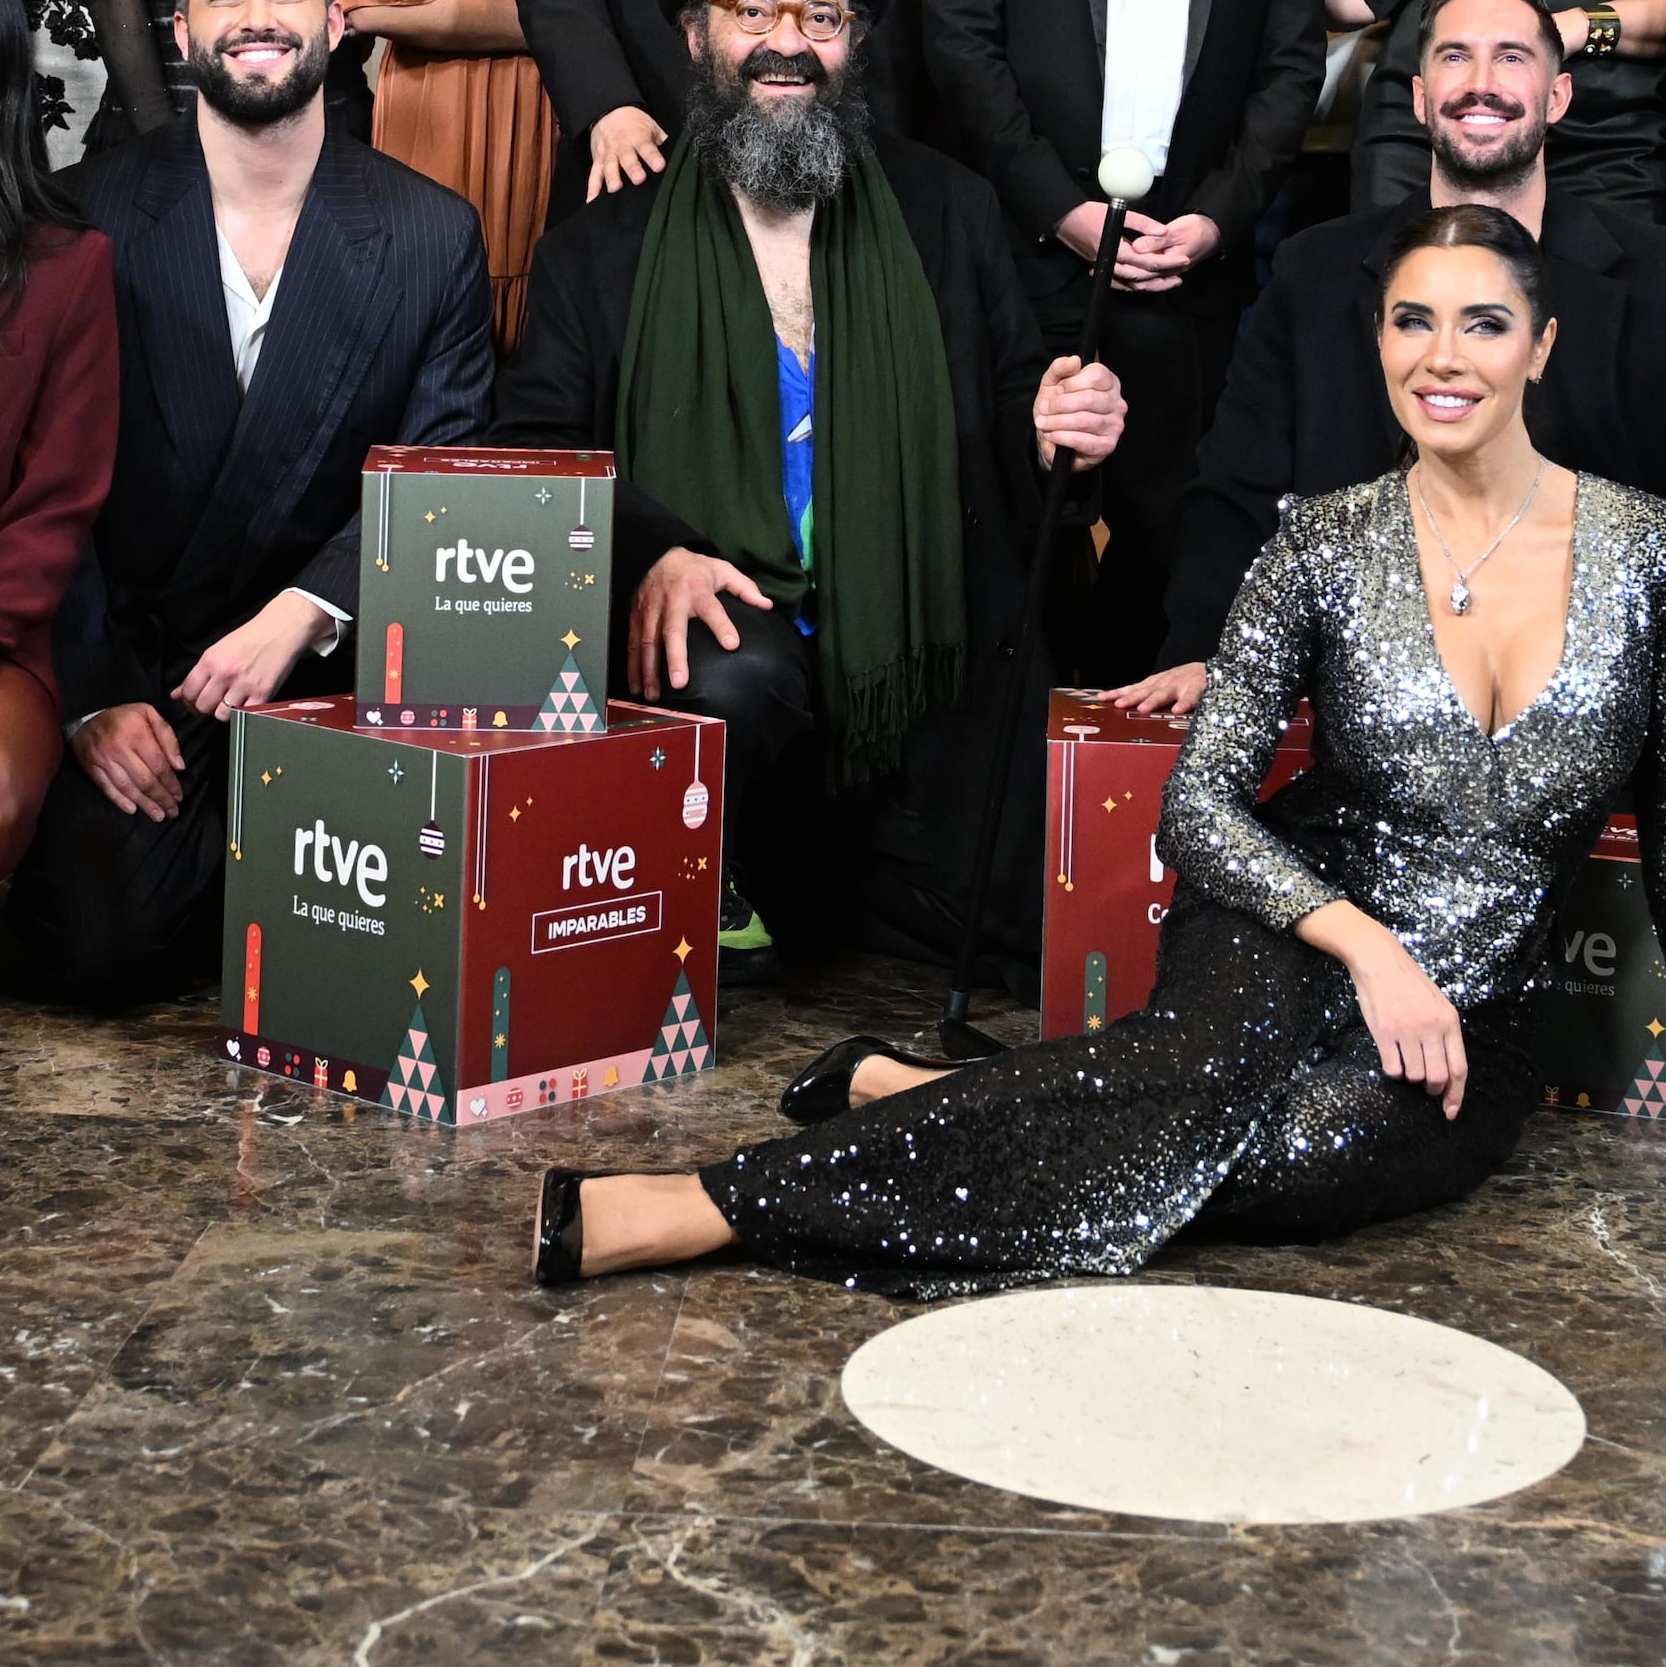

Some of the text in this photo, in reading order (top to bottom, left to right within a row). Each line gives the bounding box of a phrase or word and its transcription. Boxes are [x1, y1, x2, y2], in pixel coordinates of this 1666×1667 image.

[435, 538, 535, 594] rtve
[435, 595, 533, 615] La que quieres
[294, 819, 388, 907] rtve
[562, 843, 636, 890] rtve
[293, 895, 385, 936] La que quieres
[548, 905, 647, 940] IMPARABLES
[1564, 930, 1617, 977] ve
[1564, 979, 1616, 996] quieres
